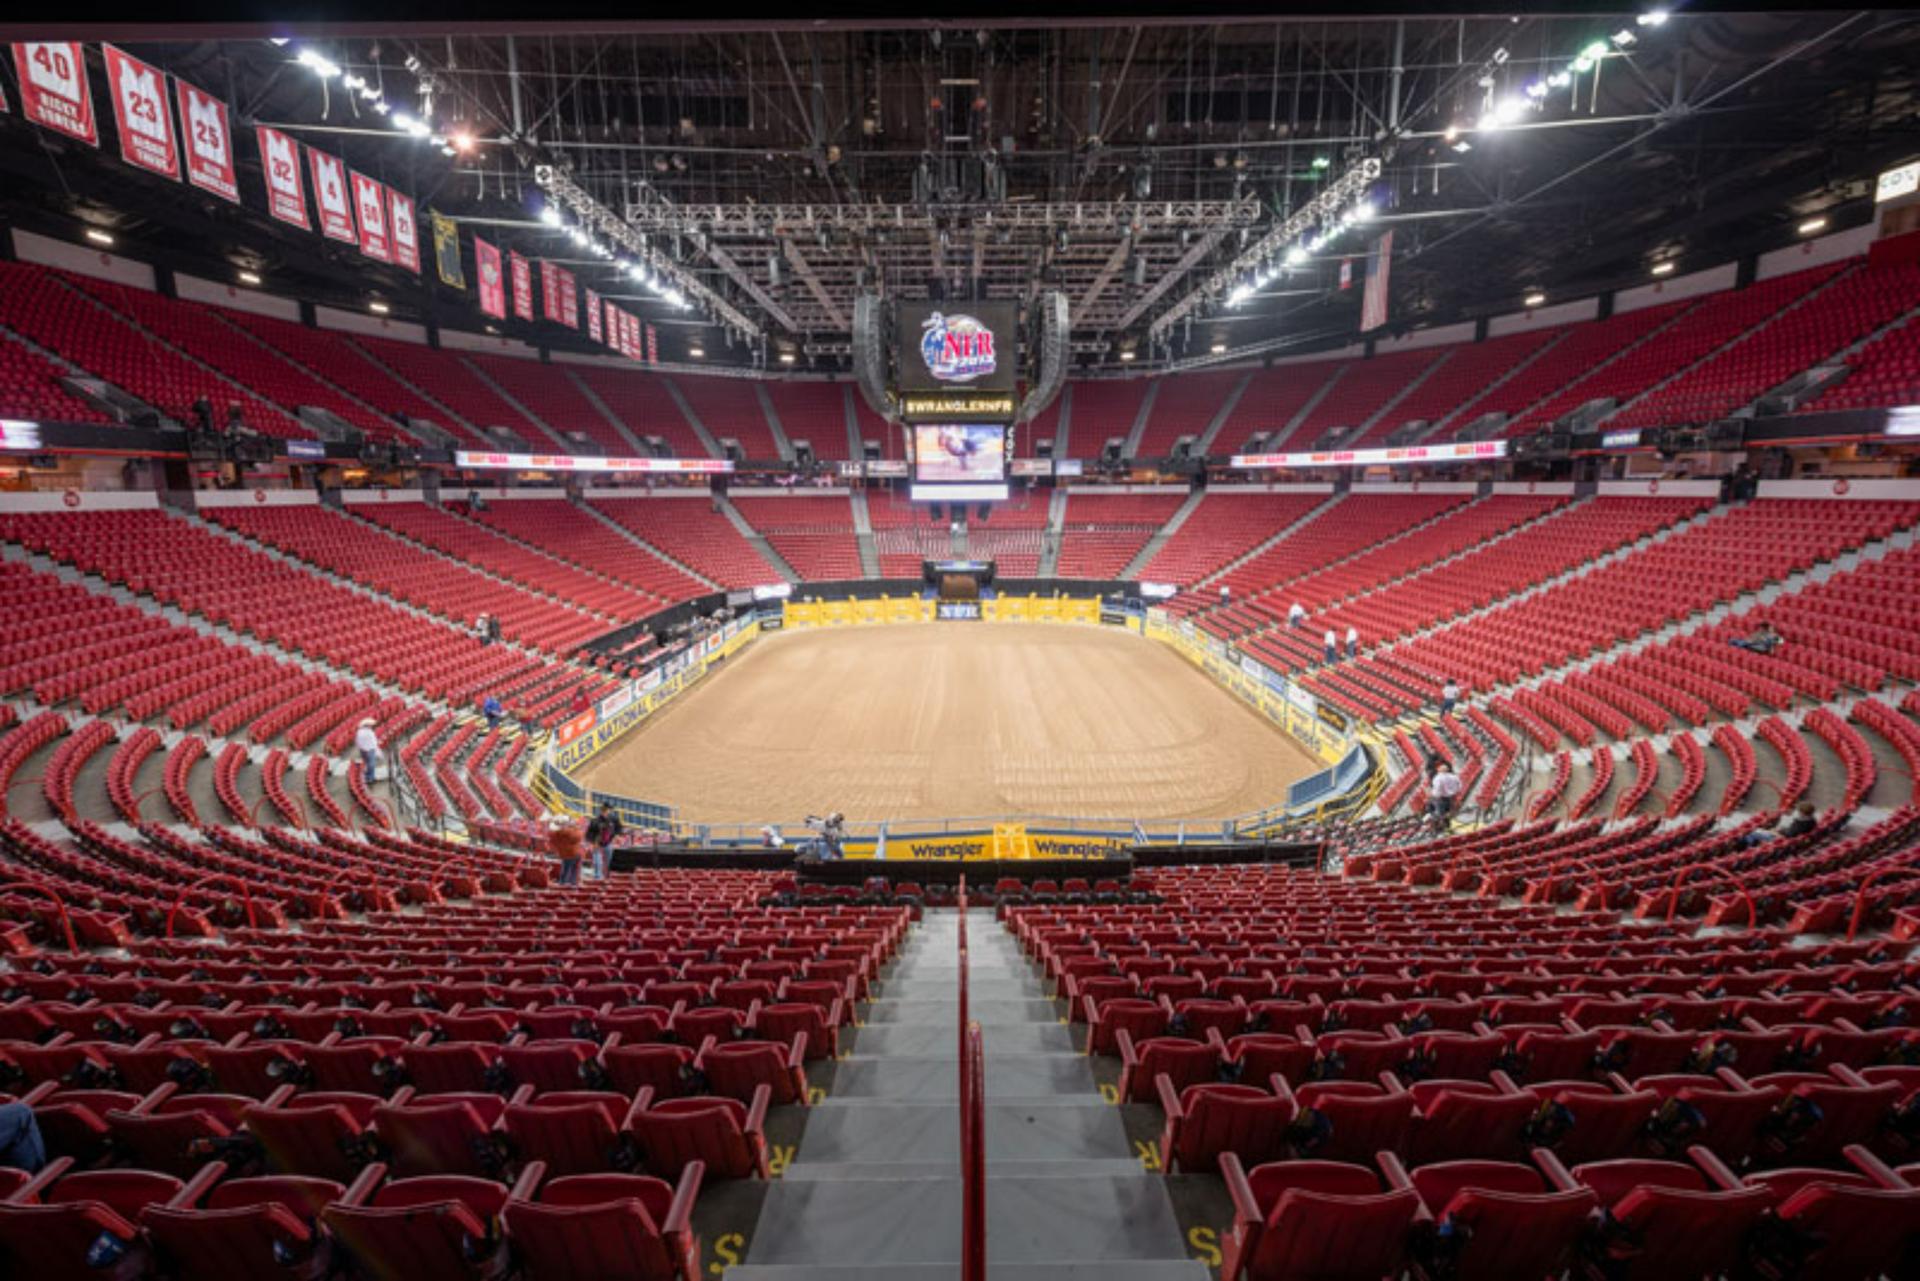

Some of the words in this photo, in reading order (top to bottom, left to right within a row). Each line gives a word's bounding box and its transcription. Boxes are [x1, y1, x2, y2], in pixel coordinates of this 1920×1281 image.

[33, 44, 71, 80] 40
[128, 90, 157, 123] 23
[196, 119, 219, 149] 25
[910, 841, 985, 860] Wrangler
[709, 1232, 745, 1274] S
[1189, 1226, 1222, 1267] S
